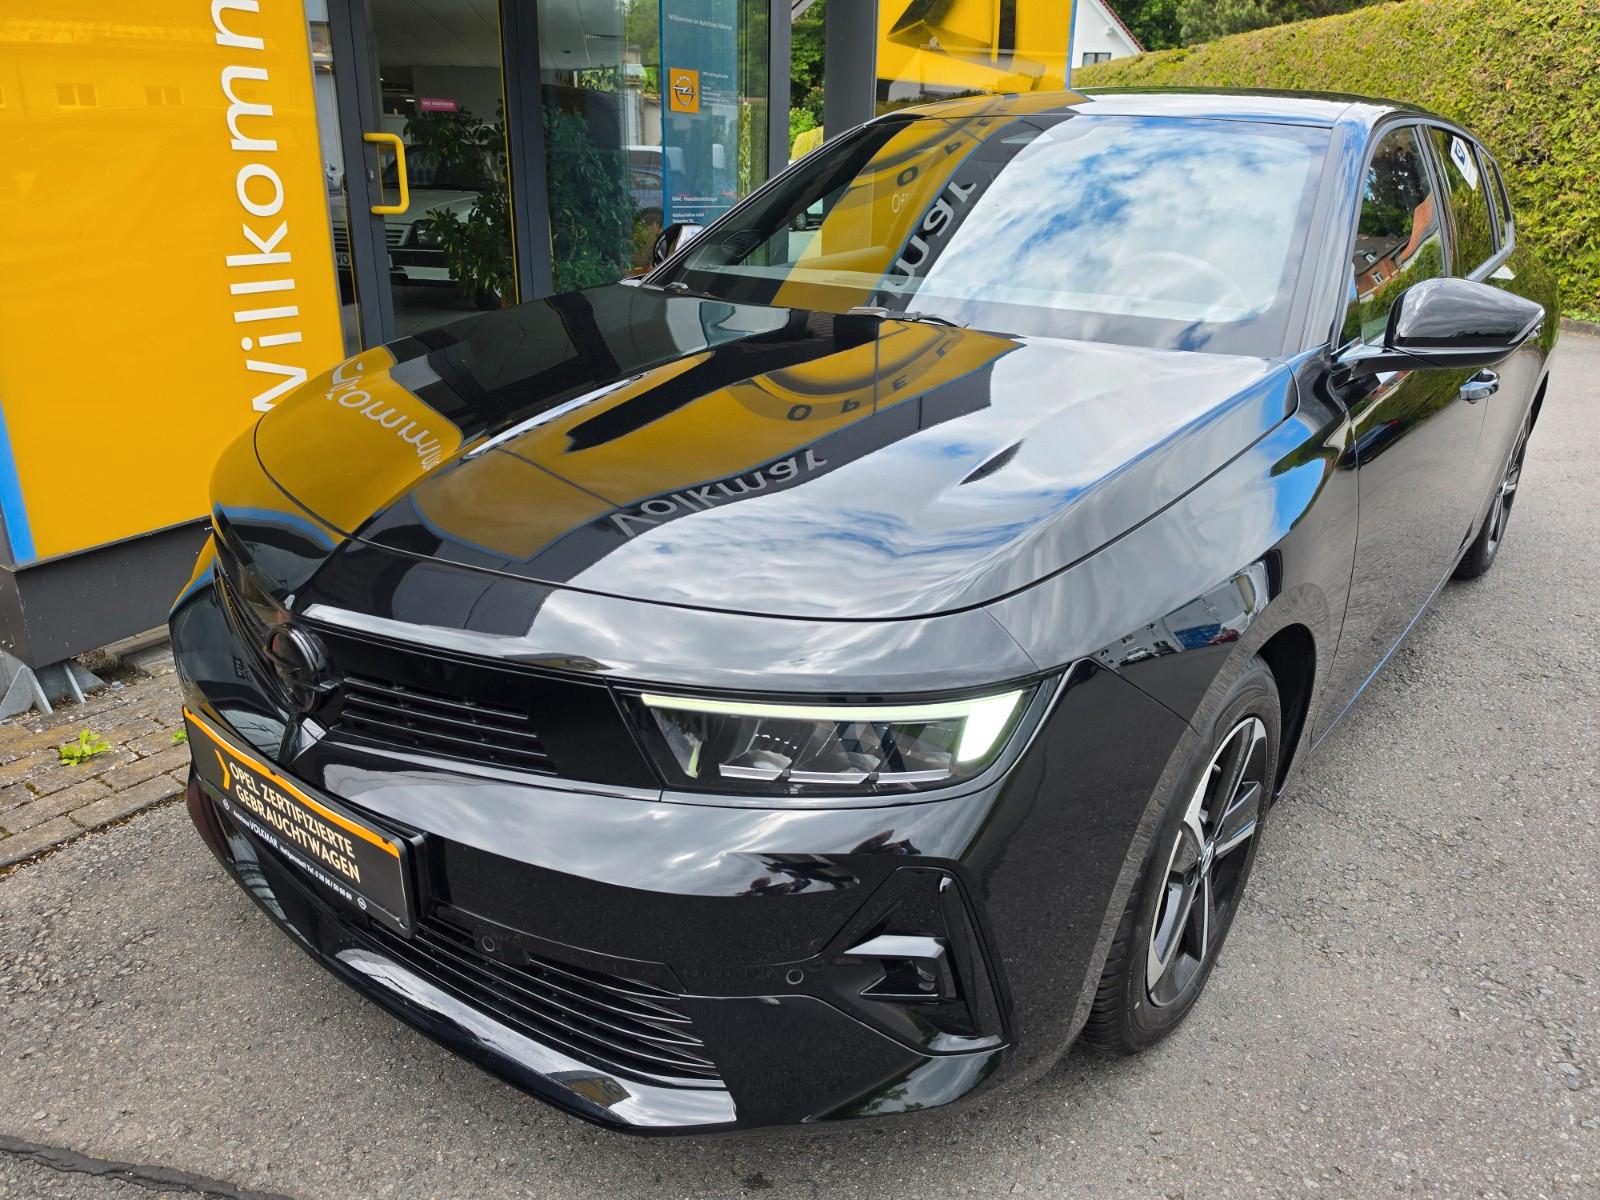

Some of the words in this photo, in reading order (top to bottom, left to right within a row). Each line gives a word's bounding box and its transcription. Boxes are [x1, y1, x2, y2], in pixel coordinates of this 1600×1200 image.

[229, 762, 260, 796] OPEL
[260, 783, 356, 859] ZERTIFIZIERTE
[235, 784, 361, 884] GEBRAUCHTWAGEN
[249, 820, 278, 848] VOLKMAR
